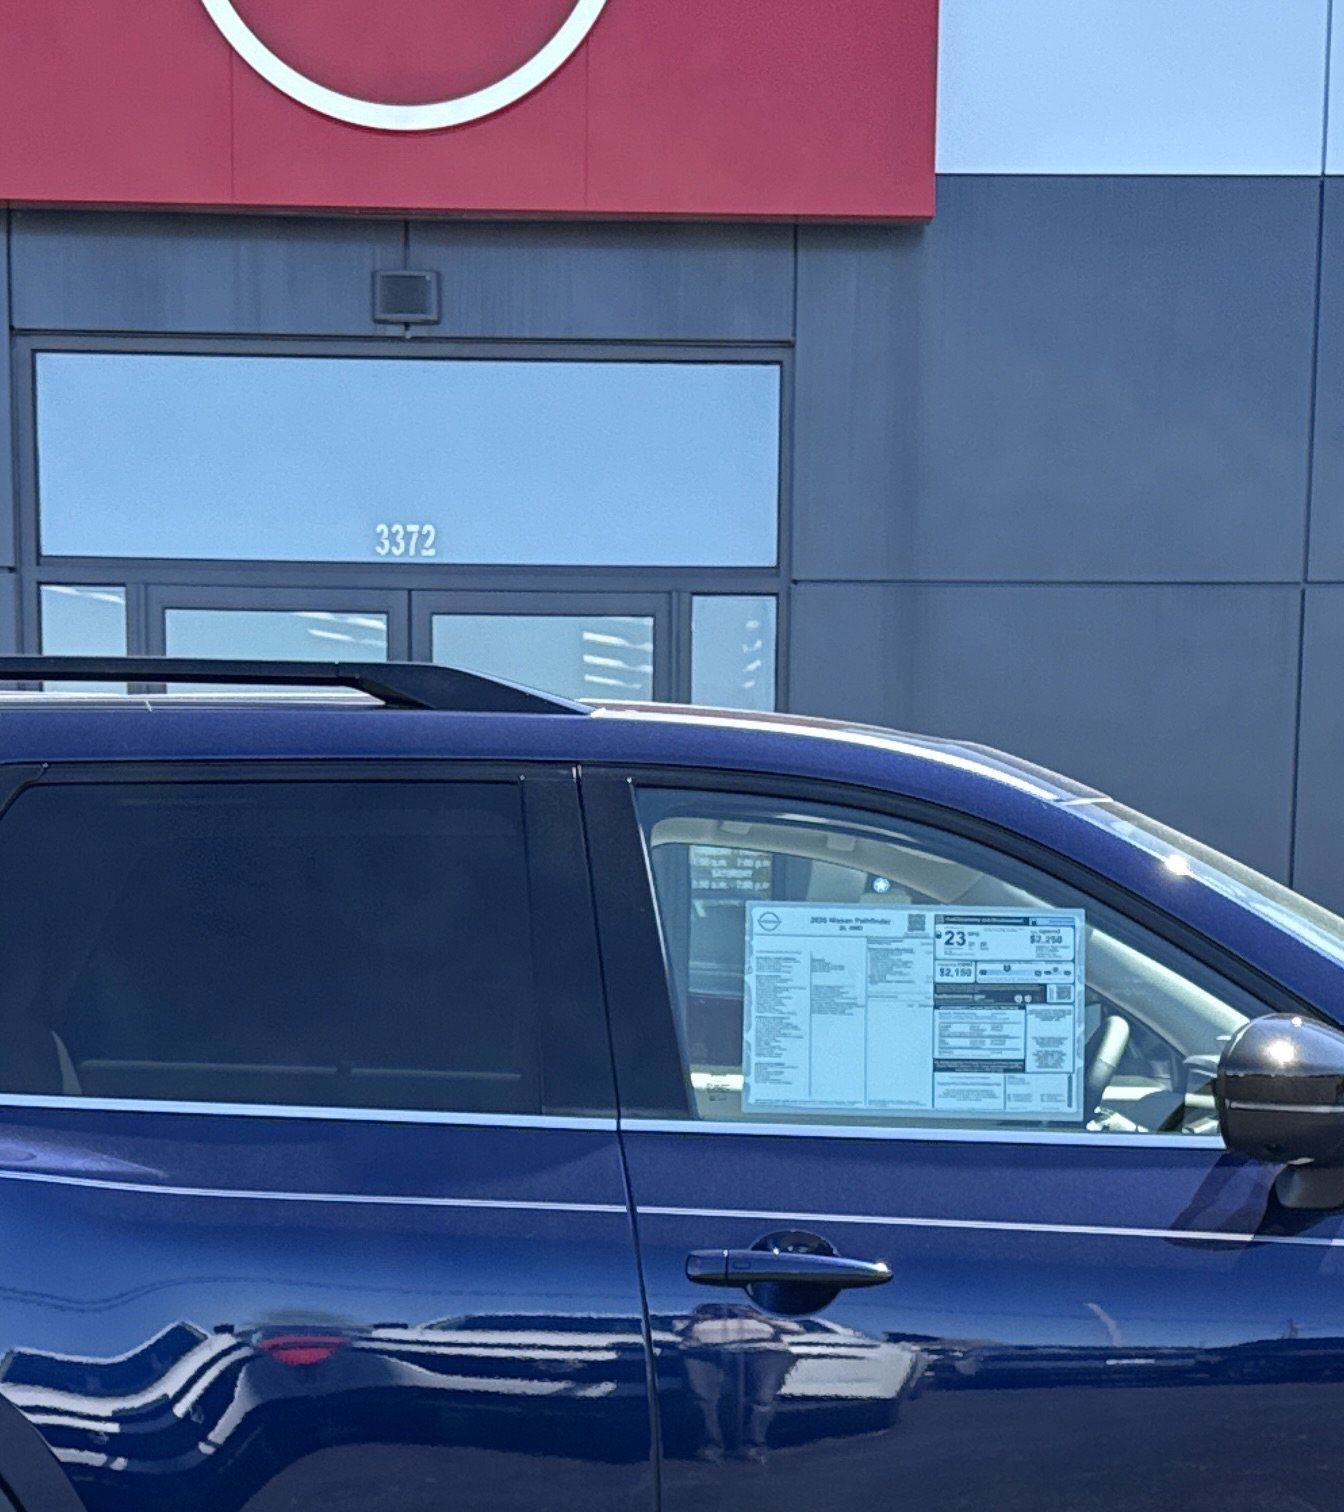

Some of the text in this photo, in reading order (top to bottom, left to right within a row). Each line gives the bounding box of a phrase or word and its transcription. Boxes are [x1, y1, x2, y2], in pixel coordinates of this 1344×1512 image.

[375, 523, 436, 557] 3372
[944, 930, 967, 947] 23
[939, 967, 972, 978] $2,150
